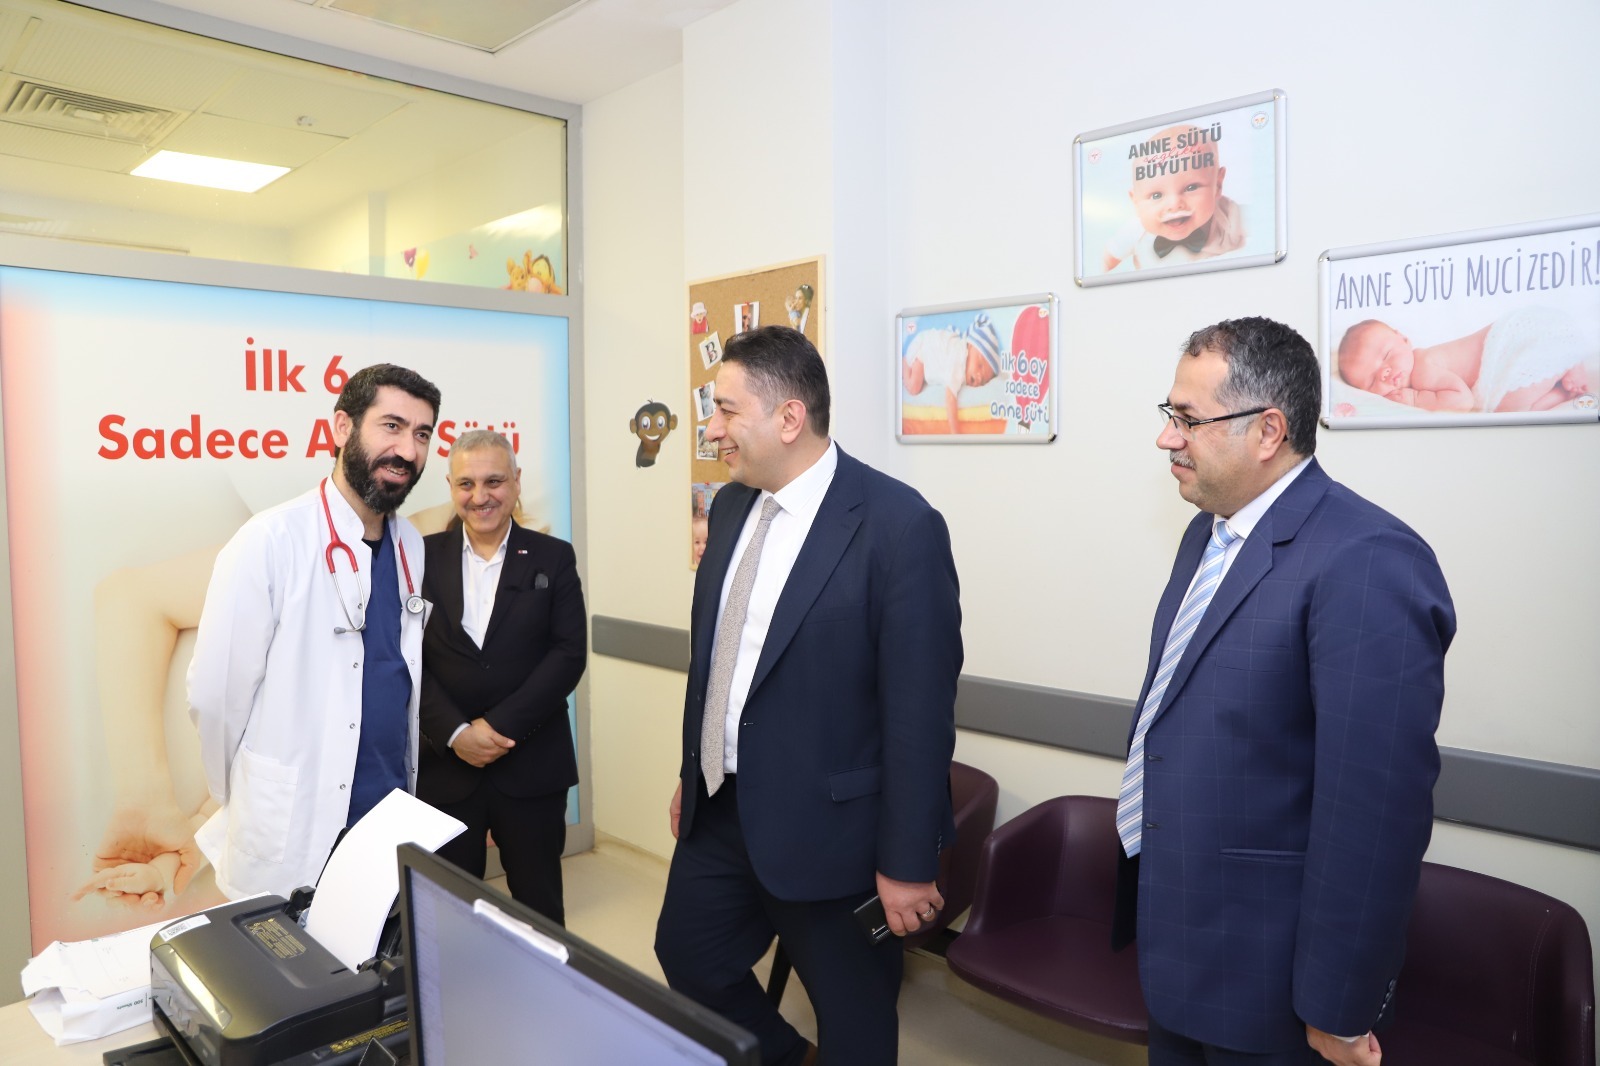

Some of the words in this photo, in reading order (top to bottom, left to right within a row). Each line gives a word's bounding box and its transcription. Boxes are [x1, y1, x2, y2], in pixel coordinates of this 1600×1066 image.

[1129, 138, 1171, 159] ANNE
[1177, 122, 1222, 149] SÜTÜ
[1135, 151, 1214, 181] BÜYÜTÜR
[1335, 272, 1392, 310] ANNE
[1403, 257, 1454, 304] SÜTÜ
[1466, 240, 1600, 297] MUCİZEDİR!
[245, 337, 307, 392] İlk
[323, 355, 349, 394] 6
[705, 341, 718, 364] B
[1002, 352, 1015, 371] ilk
[1018, 352, 1028, 373] 6
[1030, 359, 1046, 382] ay
[1005, 379, 1039, 397] sadece
[991, 402, 1022, 419] anne
[98, 414, 289, 460] Sadece
